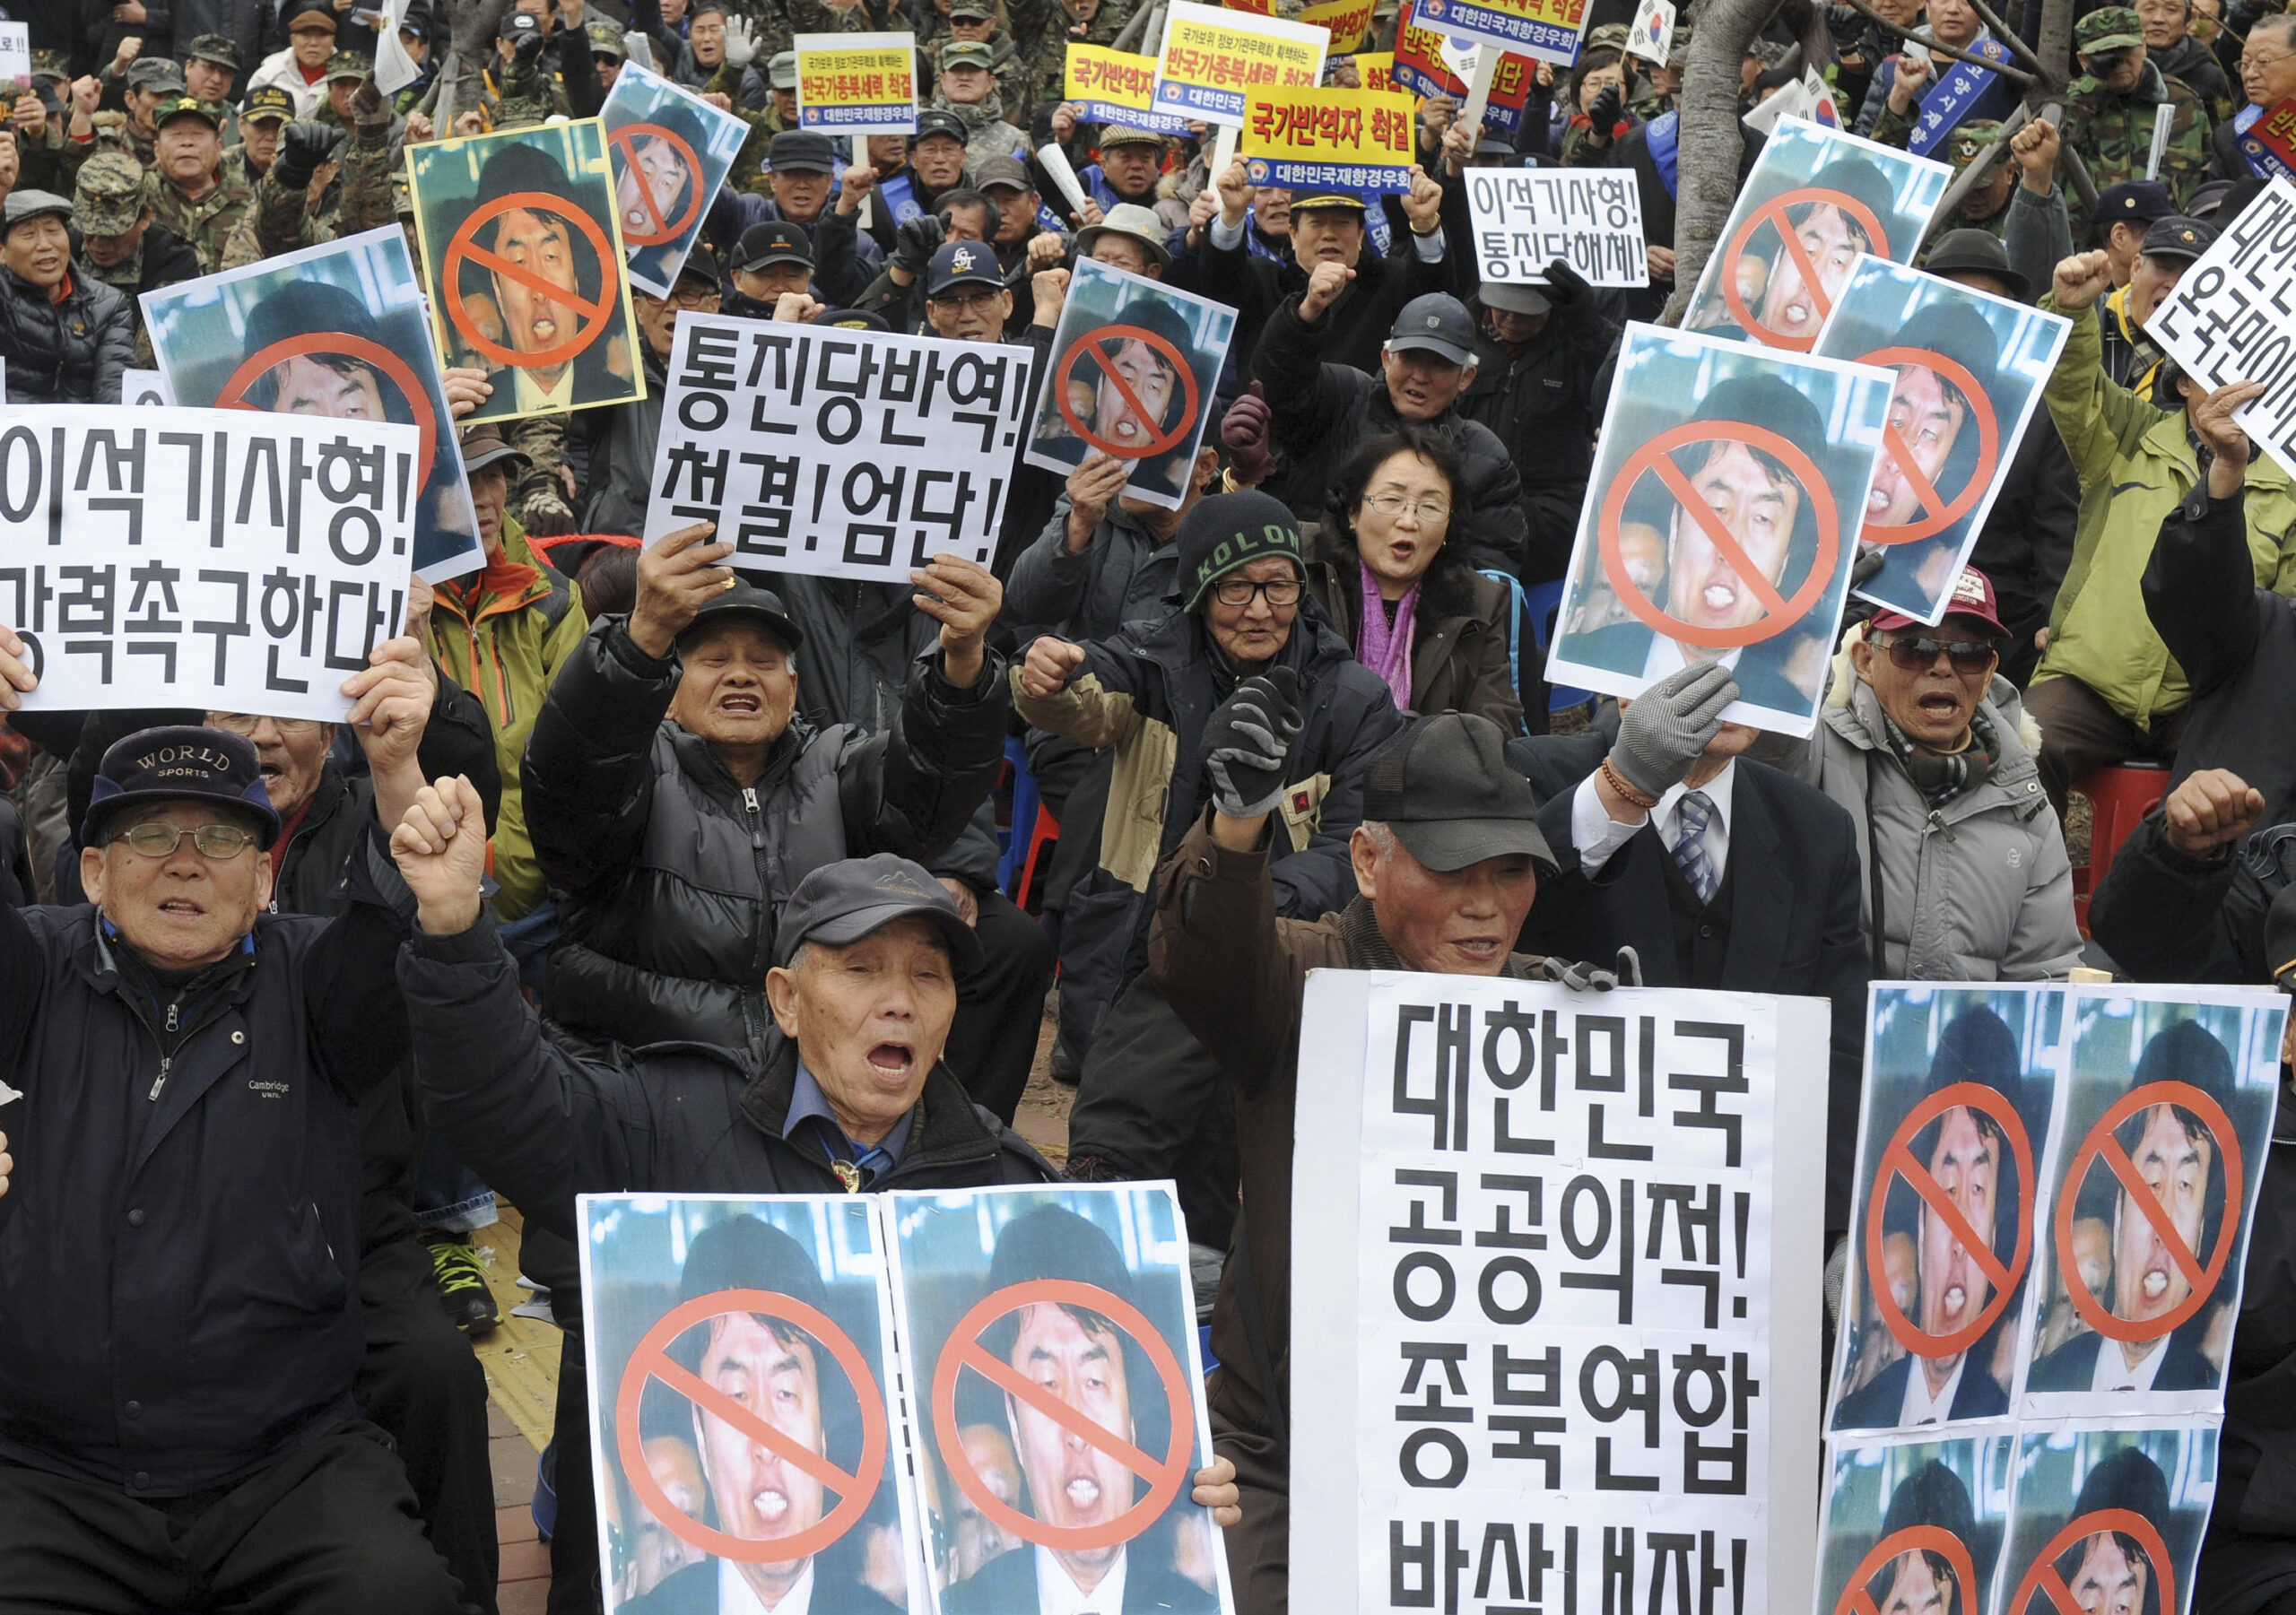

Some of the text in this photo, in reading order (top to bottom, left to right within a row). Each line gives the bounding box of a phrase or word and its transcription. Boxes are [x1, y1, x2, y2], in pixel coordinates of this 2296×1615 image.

[1450, 5, 1575, 49] 대한민국재향경우회
[1092, 103, 1189, 132] 대한민국재향경우
[1252, 102, 1409, 152] 국가반역자 척결
[1275, 164, 1411, 188] 대한민국재향경우회
[1474, 177, 1639, 230] 이석기사형!
[678, 326, 1028, 453] 통진당반역!
[0, 425, 412, 566] 이석기사형!
[1197, 525, 1300, 583] KOLON
[136, 745, 230, 771] WORLD
[158, 768, 209, 778] SPORTS
[248, 1080, 290, 1093] Cambridge
[1392, 1000, 1749, 1168] 대한민국
[1388, 1168, 1751, 1330] 공공의적!
[1395, 1341, 1760, 1495] 종북연합
